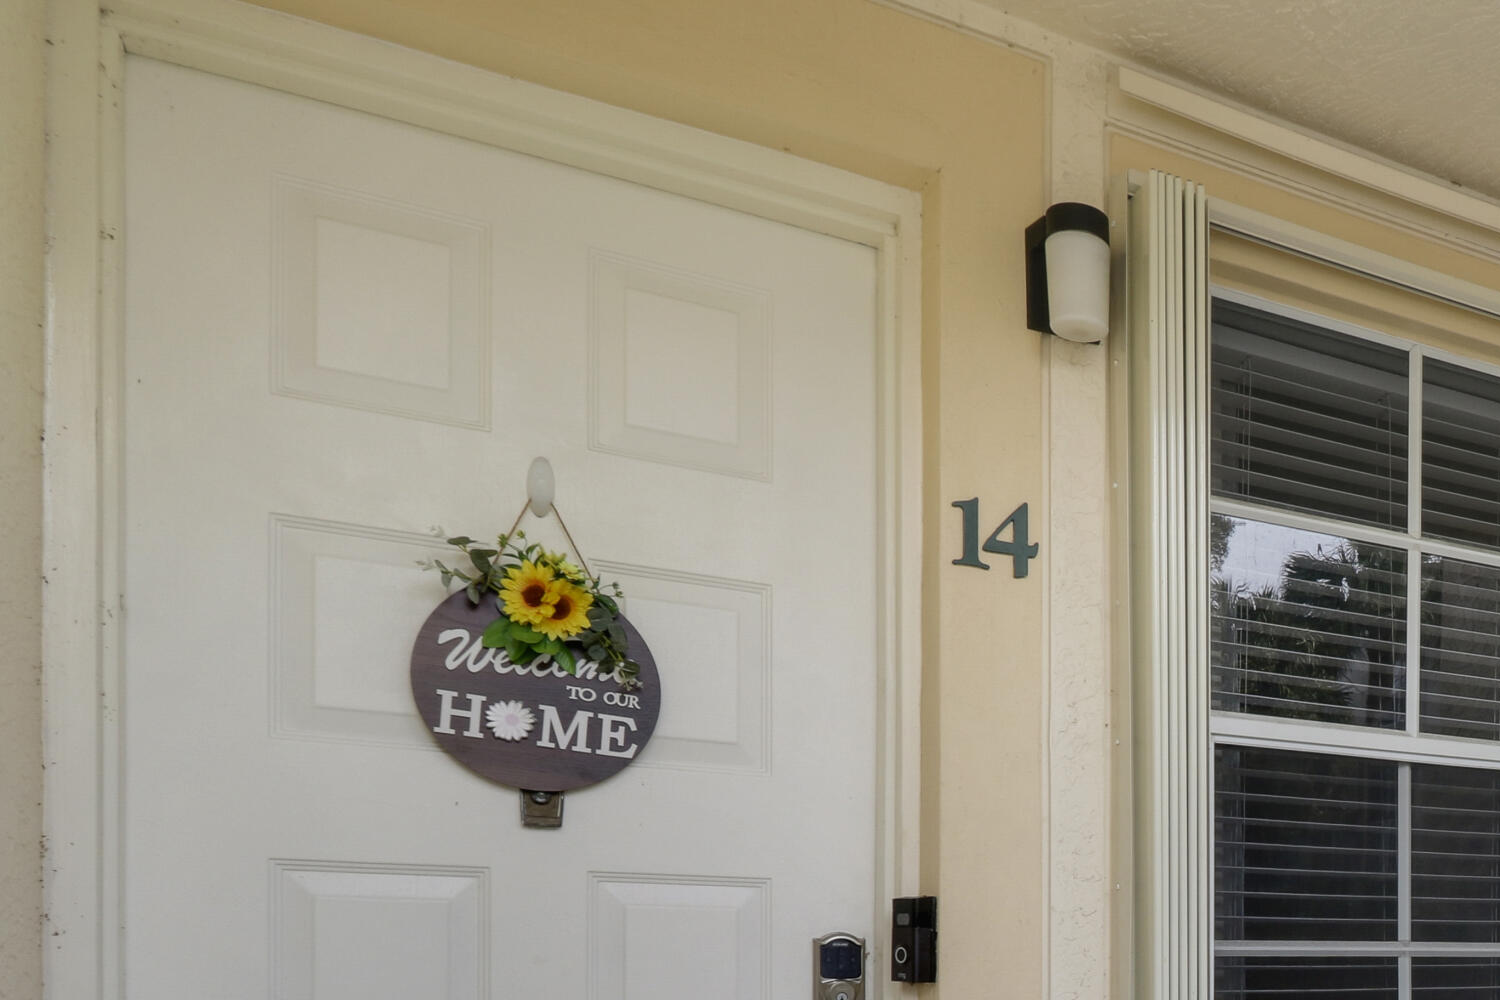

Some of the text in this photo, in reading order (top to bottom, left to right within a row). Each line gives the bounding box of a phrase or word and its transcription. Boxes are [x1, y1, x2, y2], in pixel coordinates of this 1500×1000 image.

[951, 497, 1039, 579] 14
[433, 688, 639, 759] HME
[566, 685, 641, 710] TO OUR
